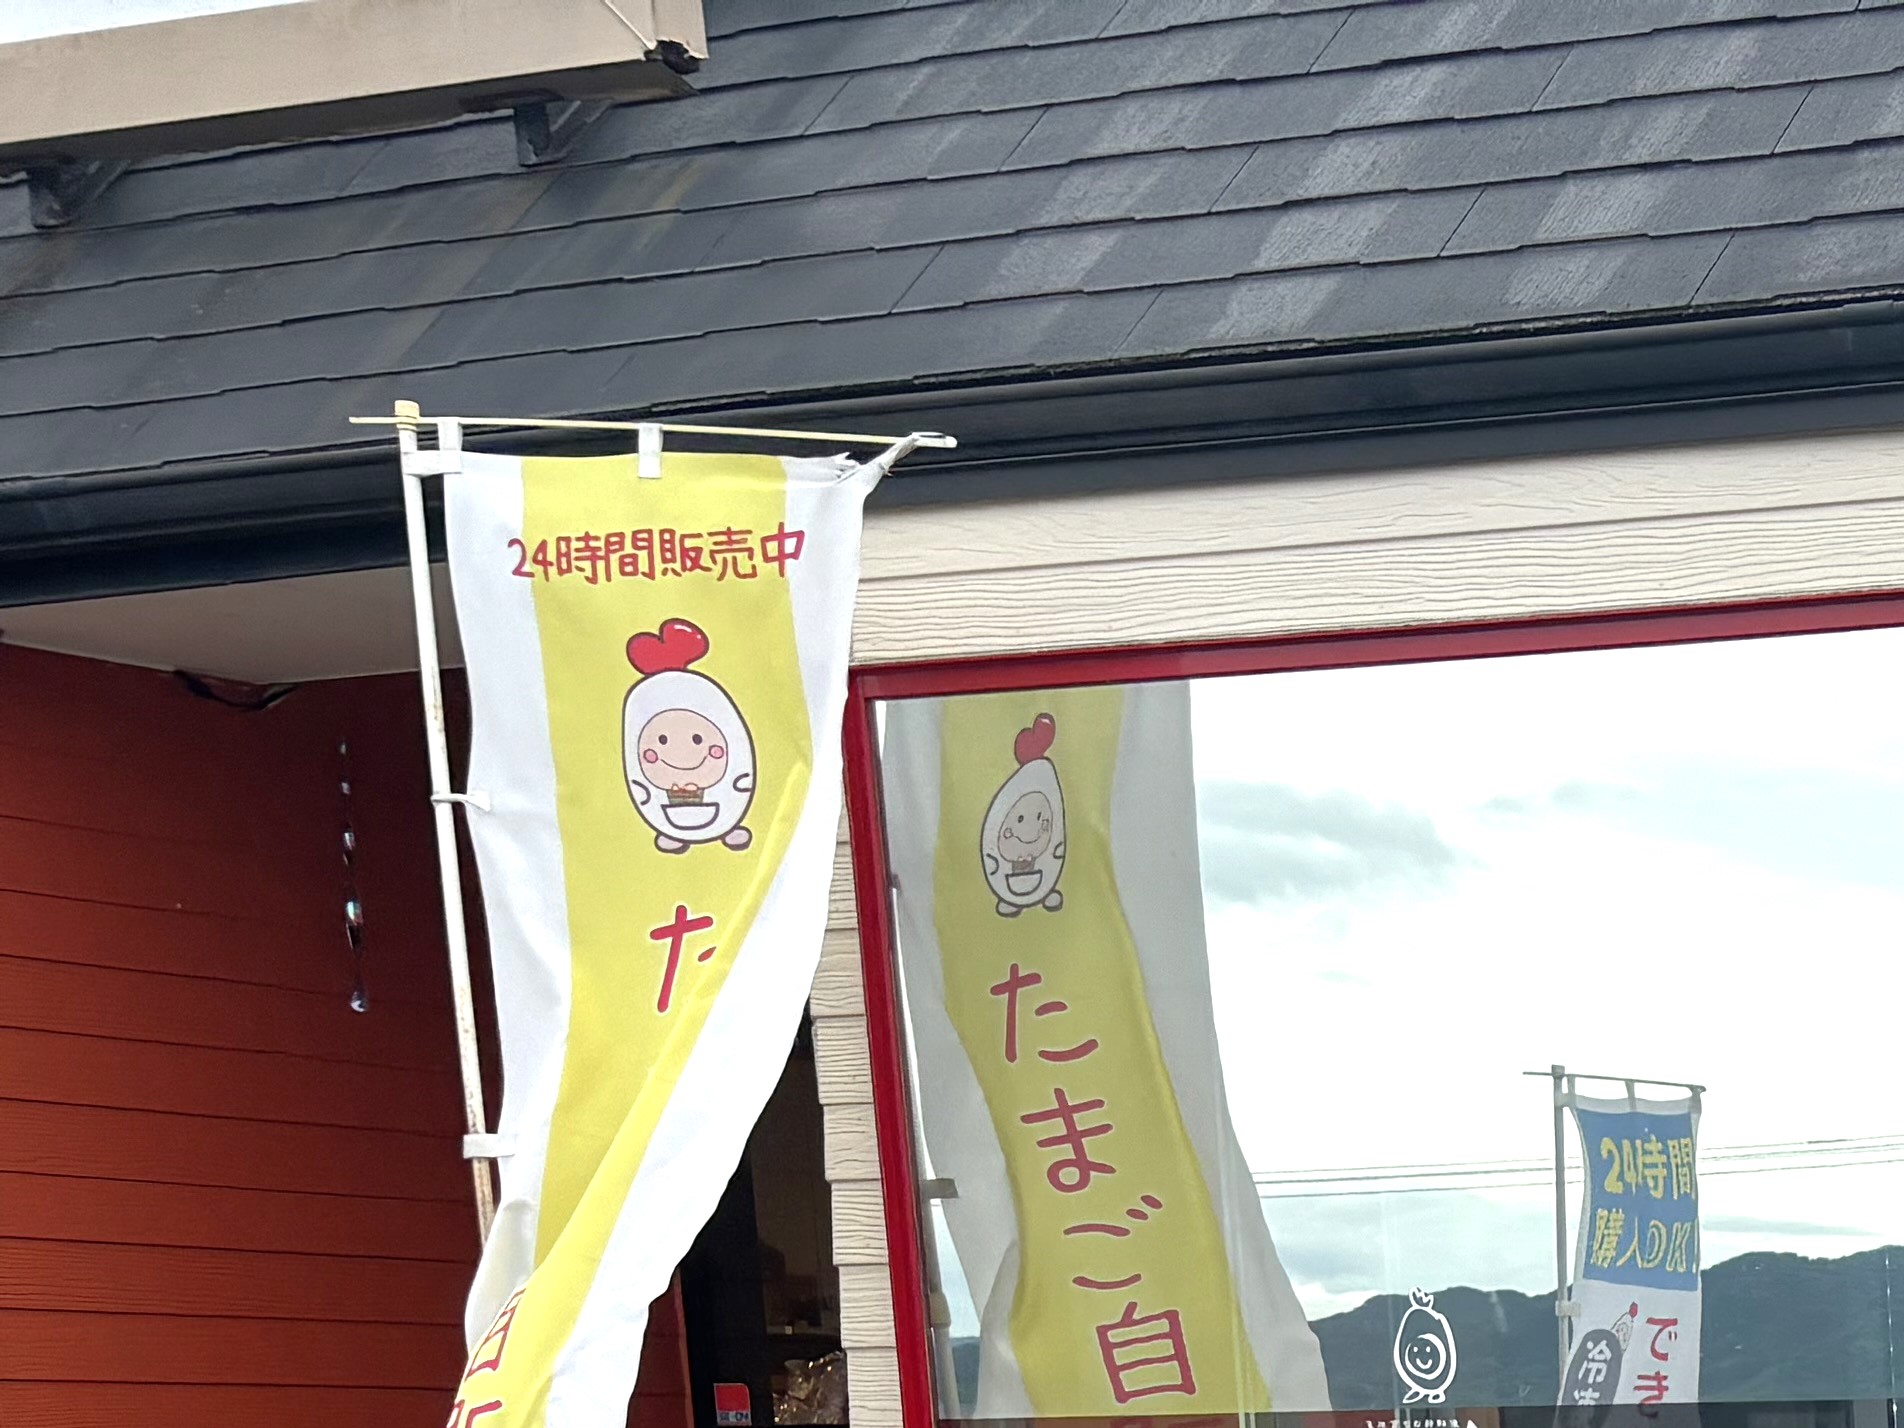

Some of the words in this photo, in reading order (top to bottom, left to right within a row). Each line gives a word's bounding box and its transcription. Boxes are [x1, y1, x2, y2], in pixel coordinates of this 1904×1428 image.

[508, 521, 805, 585] 24時間販売中
